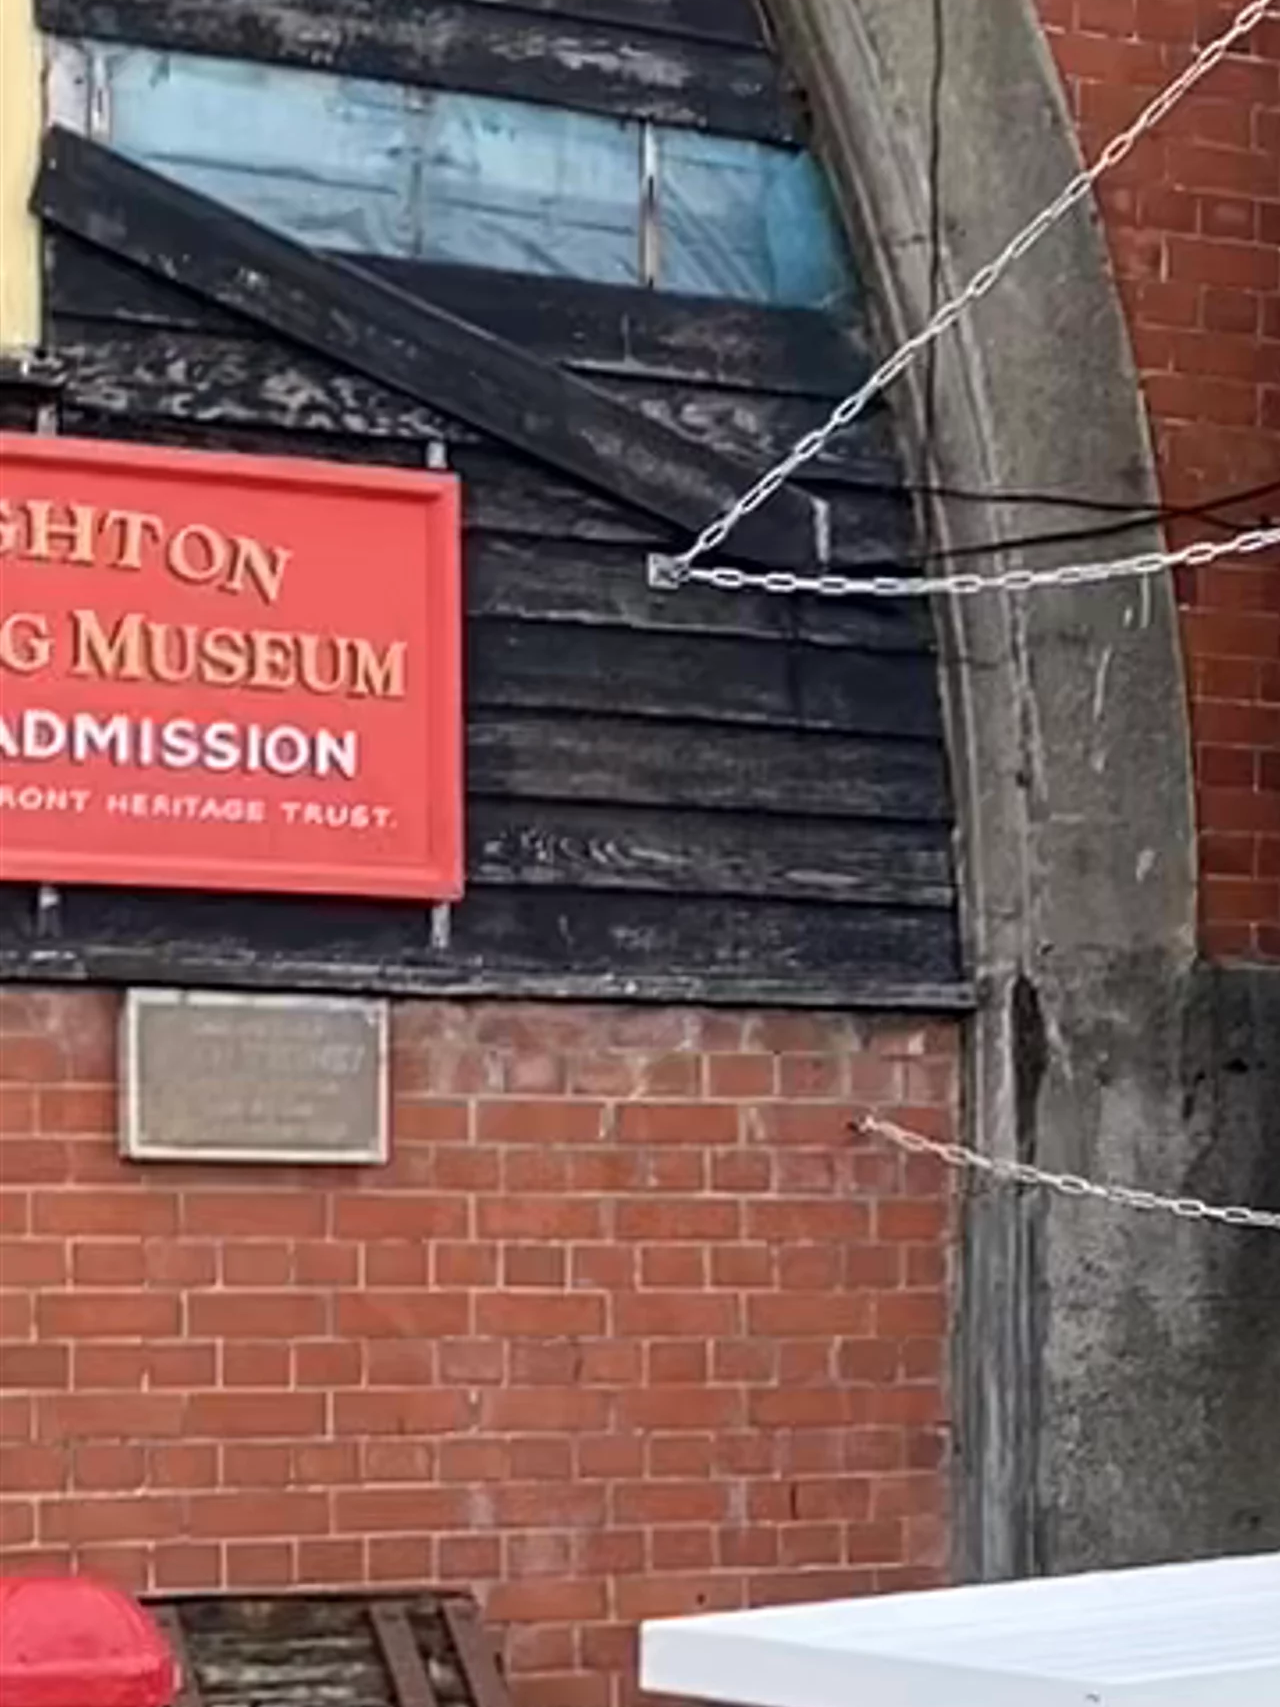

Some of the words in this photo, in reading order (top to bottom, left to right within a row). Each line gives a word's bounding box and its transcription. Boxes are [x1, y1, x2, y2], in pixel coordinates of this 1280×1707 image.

[71, 608, 408, 698] MUSEUM
[106, 793, 264, 822] HERITAGE
[281, 801, 398, 828] TRUST.
